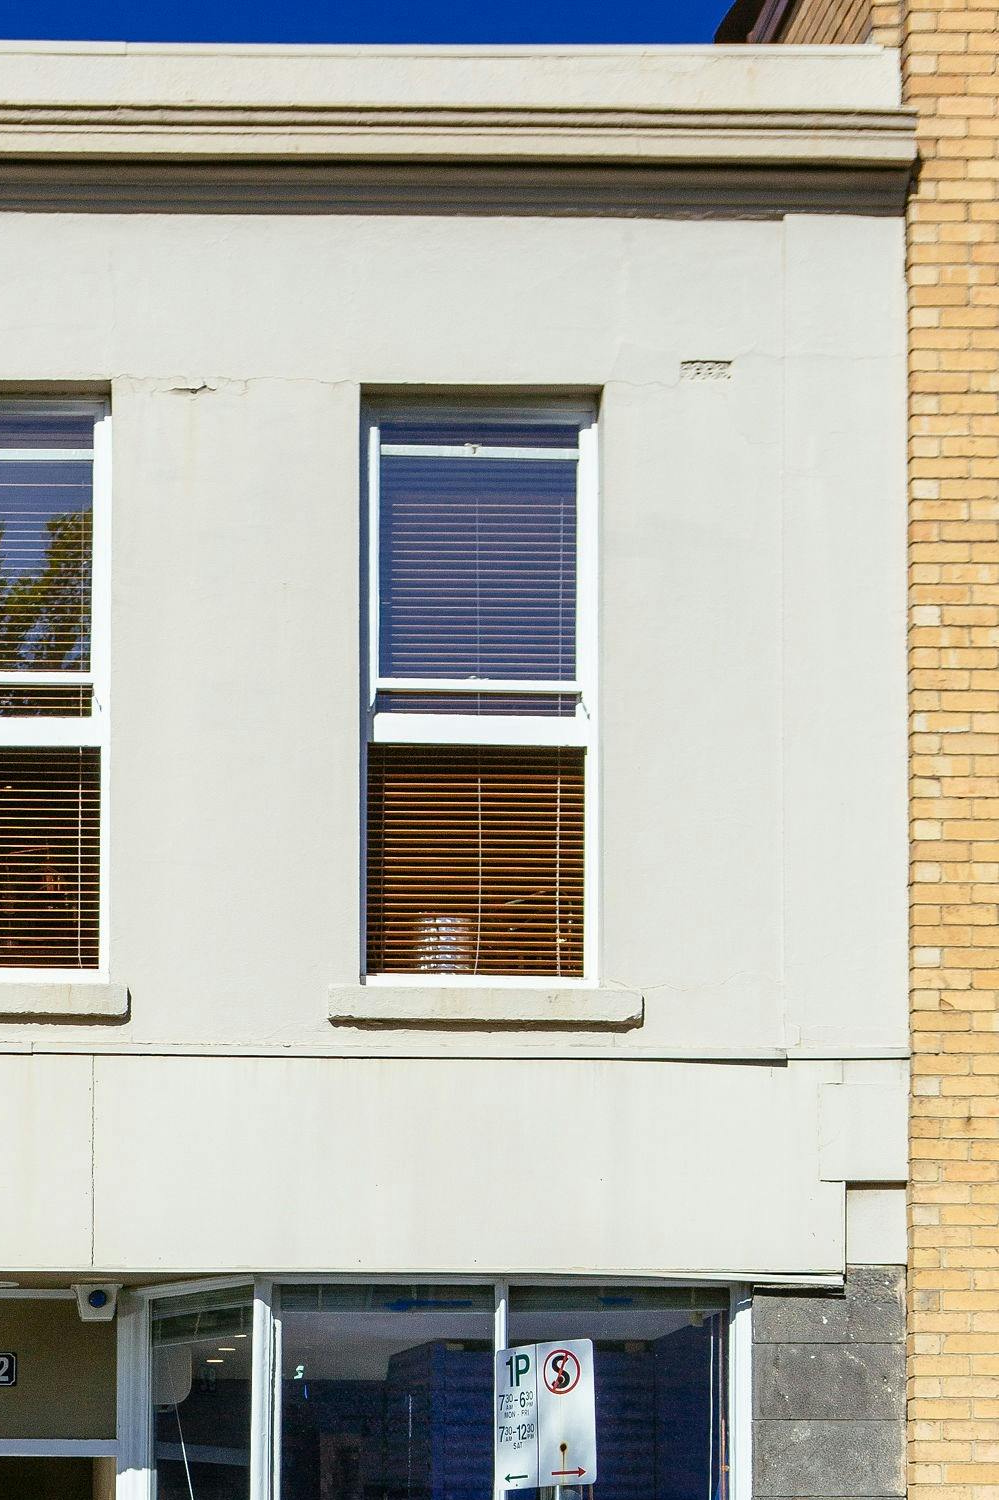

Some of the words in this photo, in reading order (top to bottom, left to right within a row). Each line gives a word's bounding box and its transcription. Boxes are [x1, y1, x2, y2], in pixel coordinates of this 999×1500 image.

[506, 1353, 530, 1387] 1P
[504, 1411, 516, 1419] MON
[513, 1442, 523, 1450] SAT
